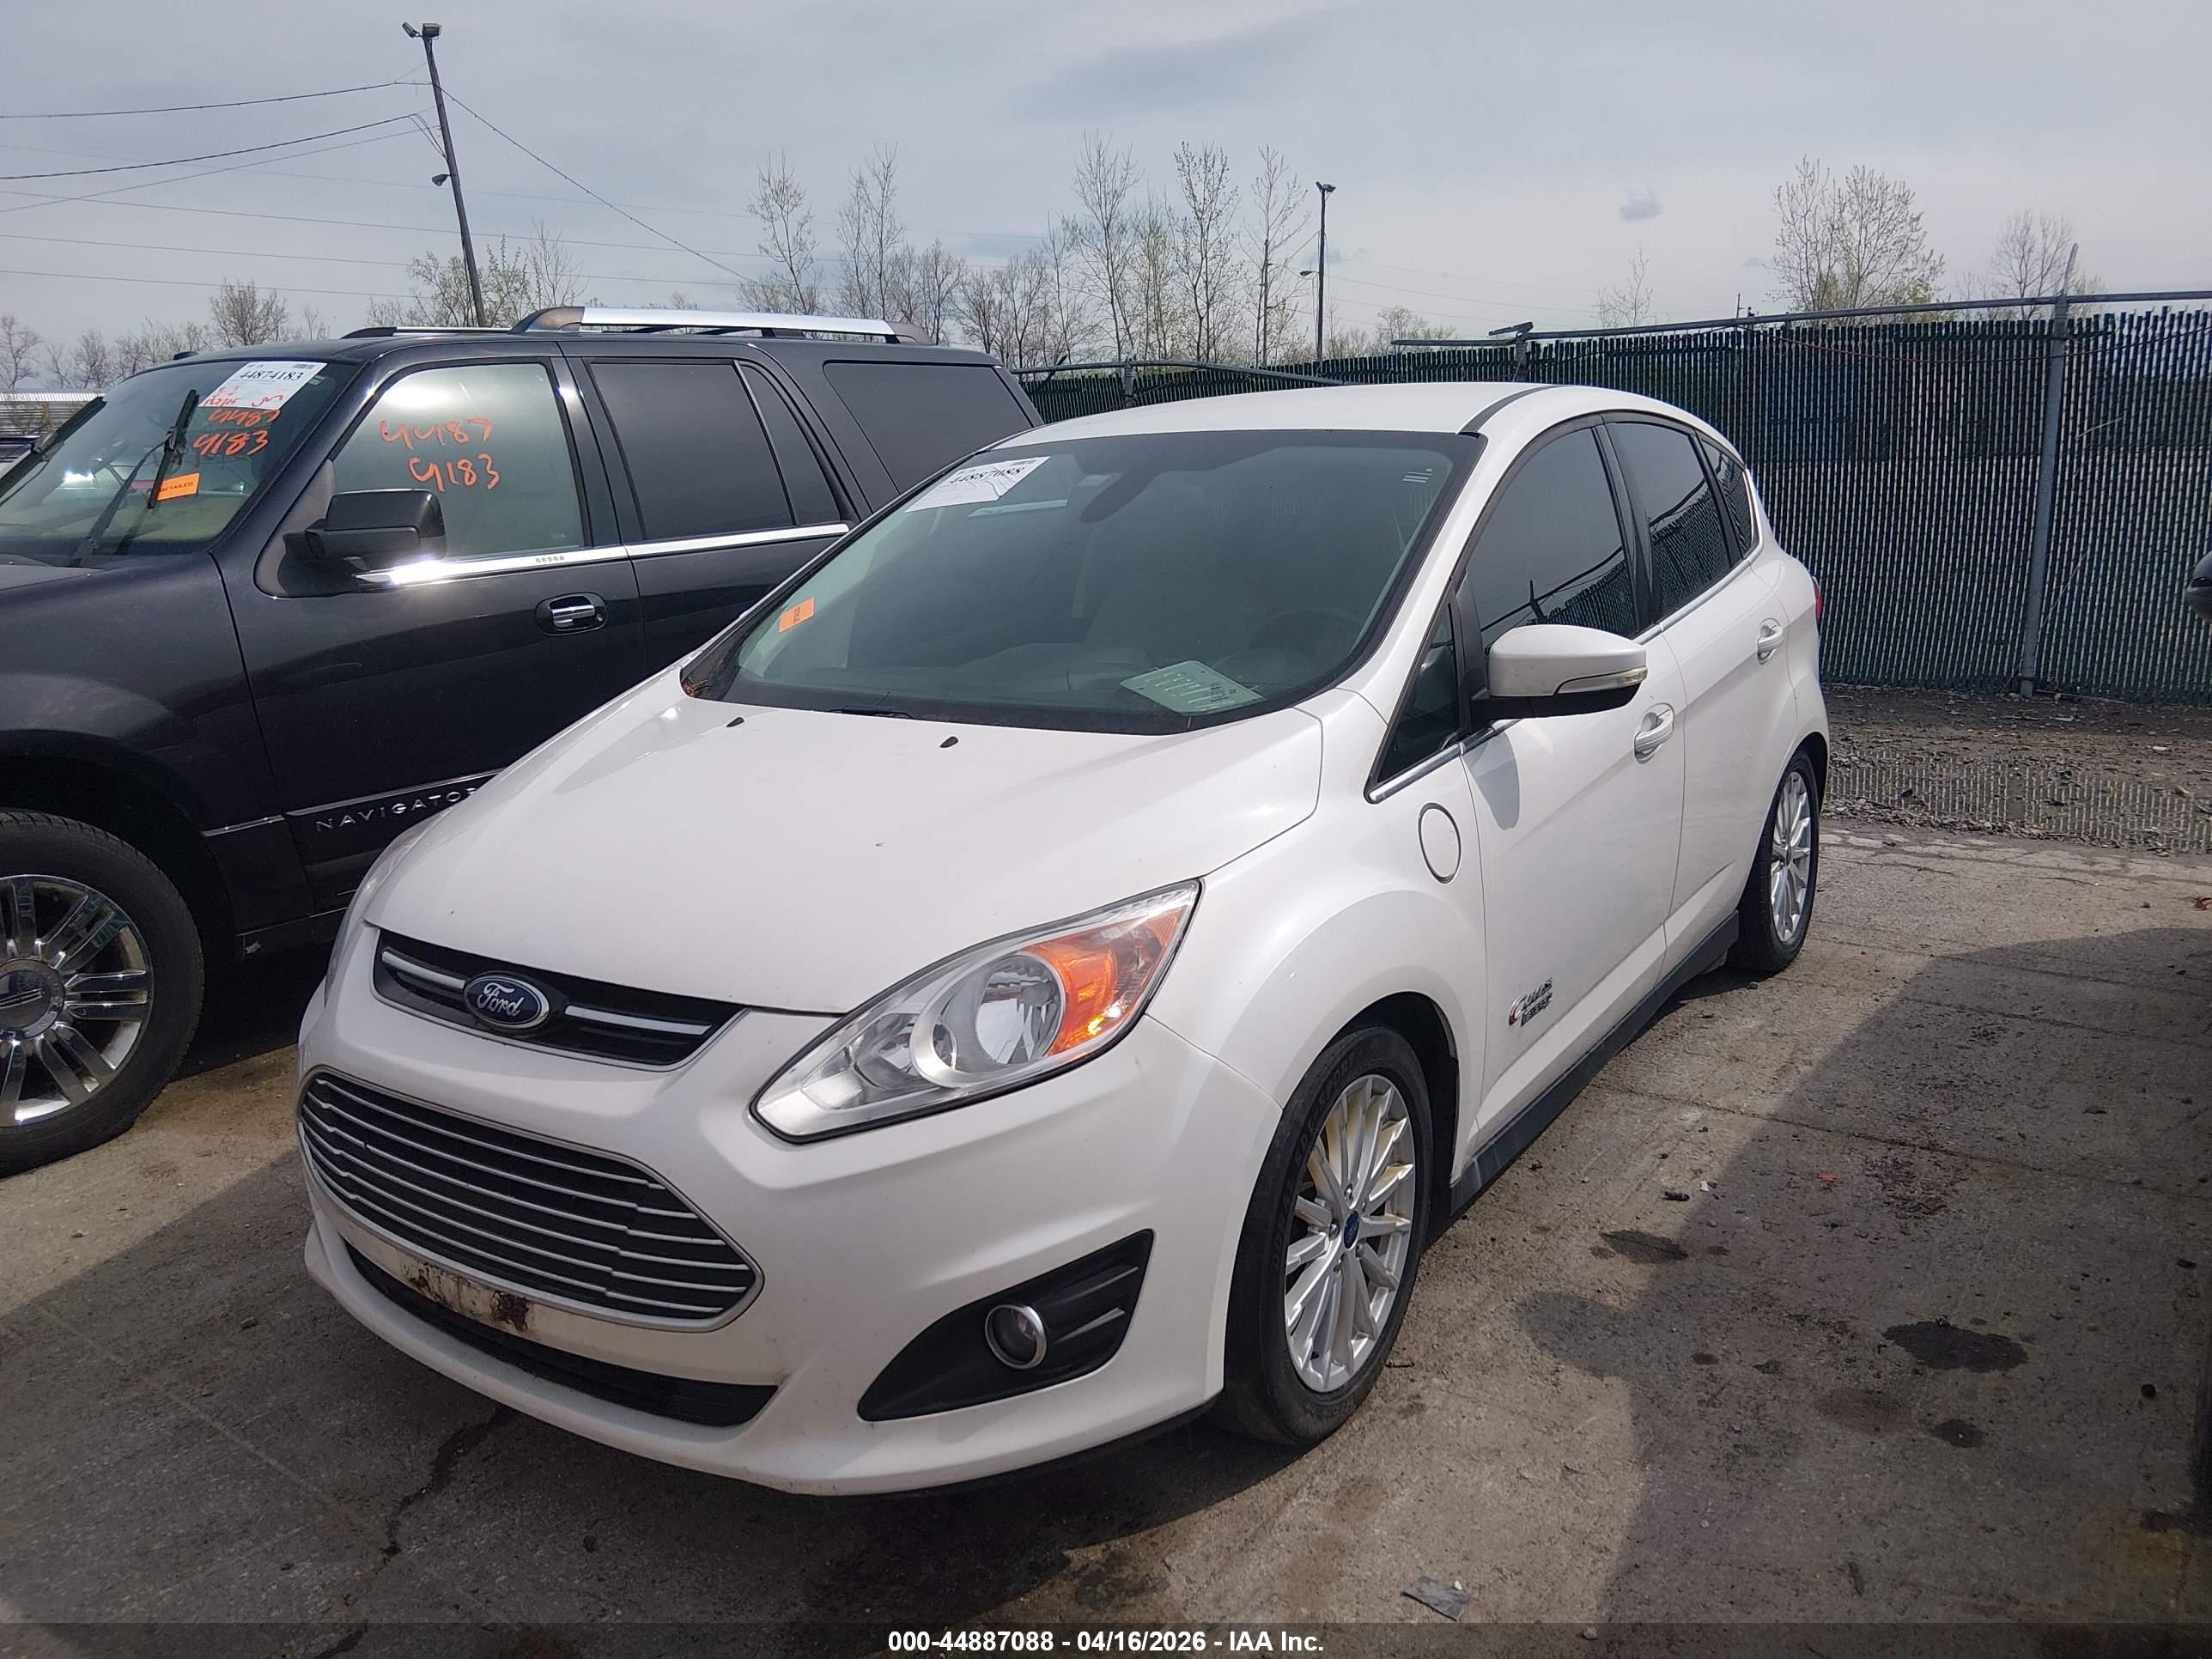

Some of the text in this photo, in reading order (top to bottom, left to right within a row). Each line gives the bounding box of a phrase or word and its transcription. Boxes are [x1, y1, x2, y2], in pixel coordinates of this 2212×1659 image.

[239, 370, 305, 381] 44874183
[192, 429, 269, 456] 4183
[379, 419, 492, 451] 4487
[409, 453, 501, 493] 4183
[477, 982, 525, 1017] Ford
